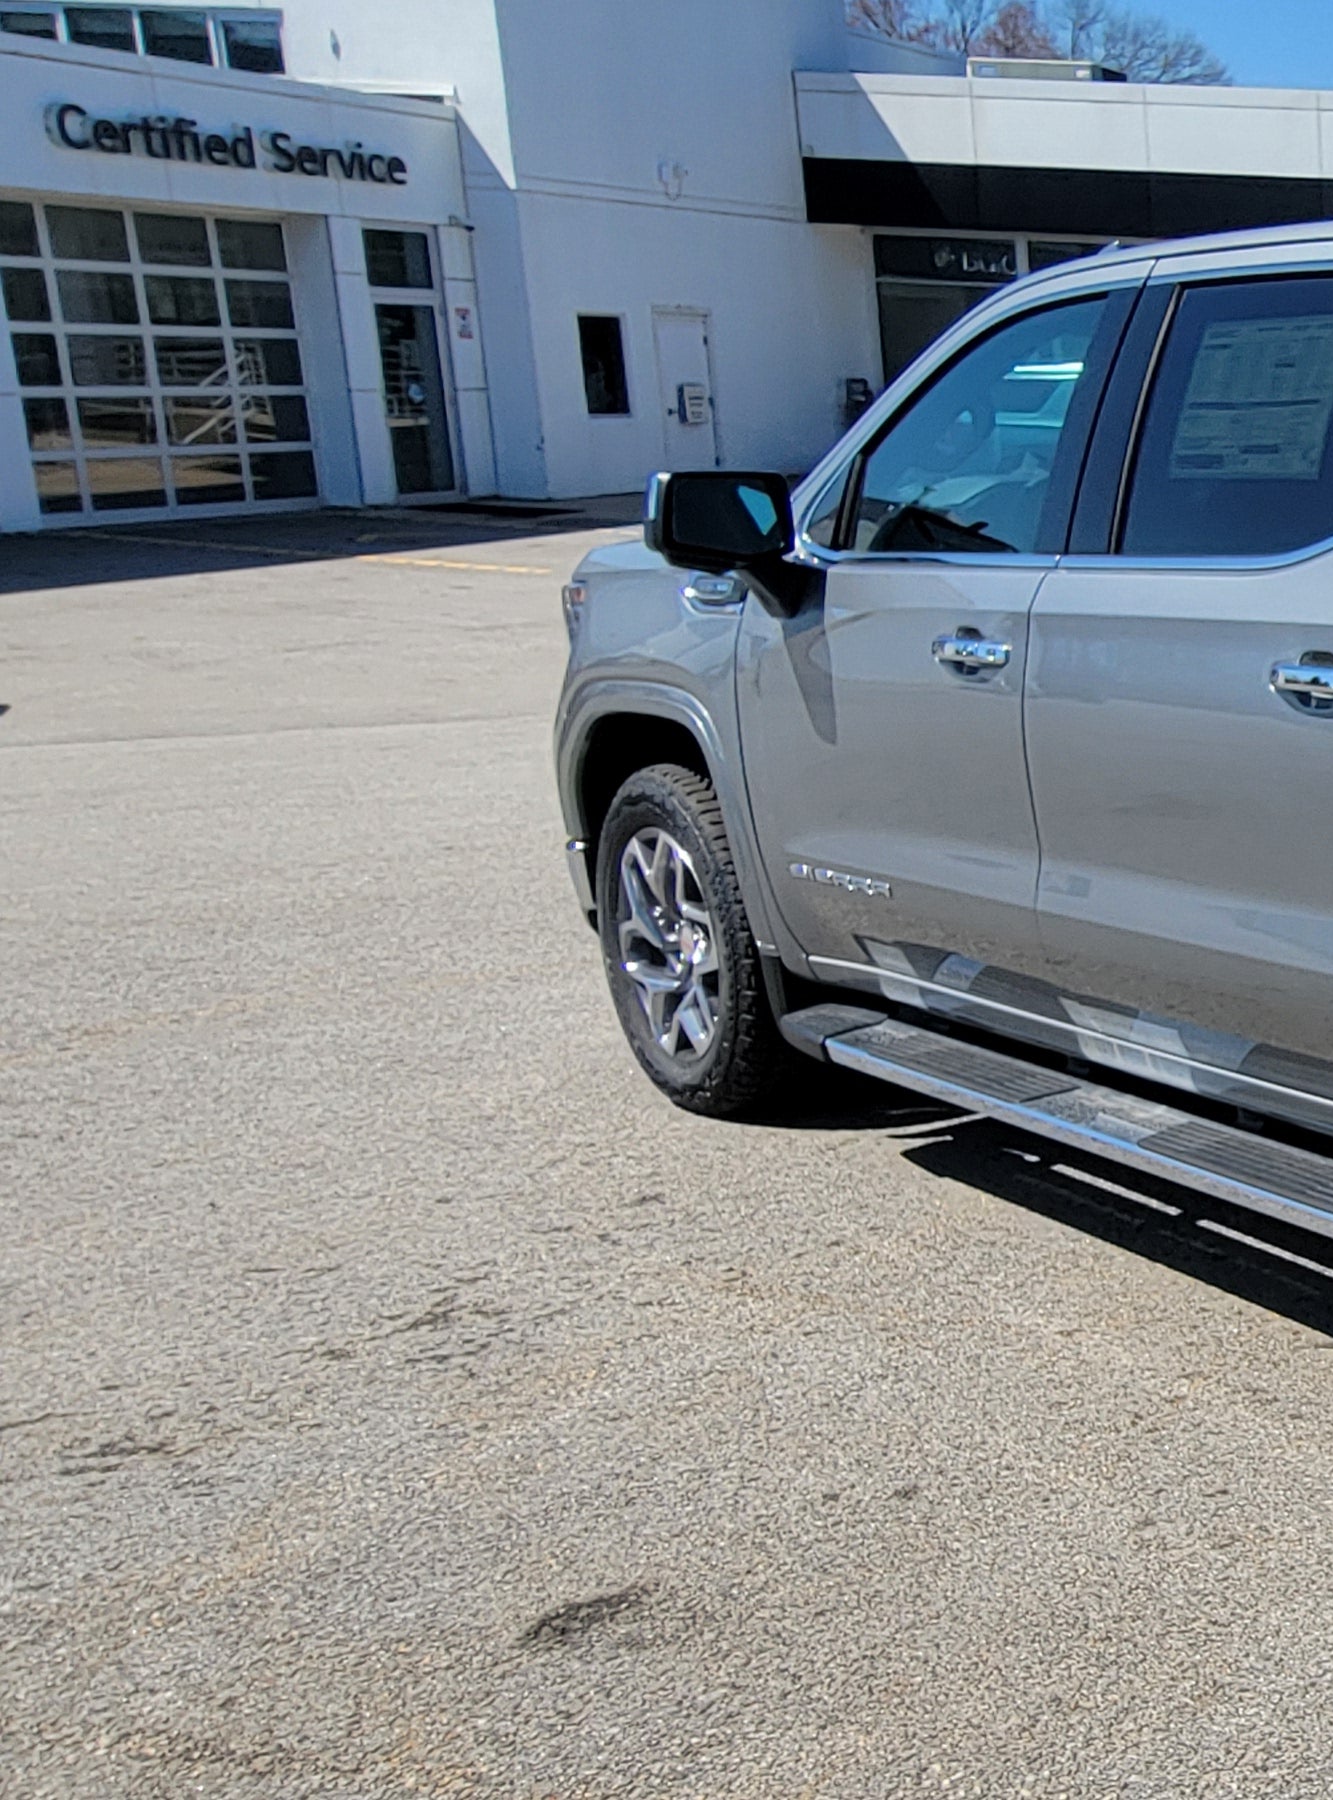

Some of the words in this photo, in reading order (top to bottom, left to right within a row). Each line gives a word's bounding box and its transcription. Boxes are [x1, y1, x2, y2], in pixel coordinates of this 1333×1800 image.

[57, 104, 256, 169] Certified
[271, 131, 408, 185] Service
[789, 862, 893, 899] SIERRA
